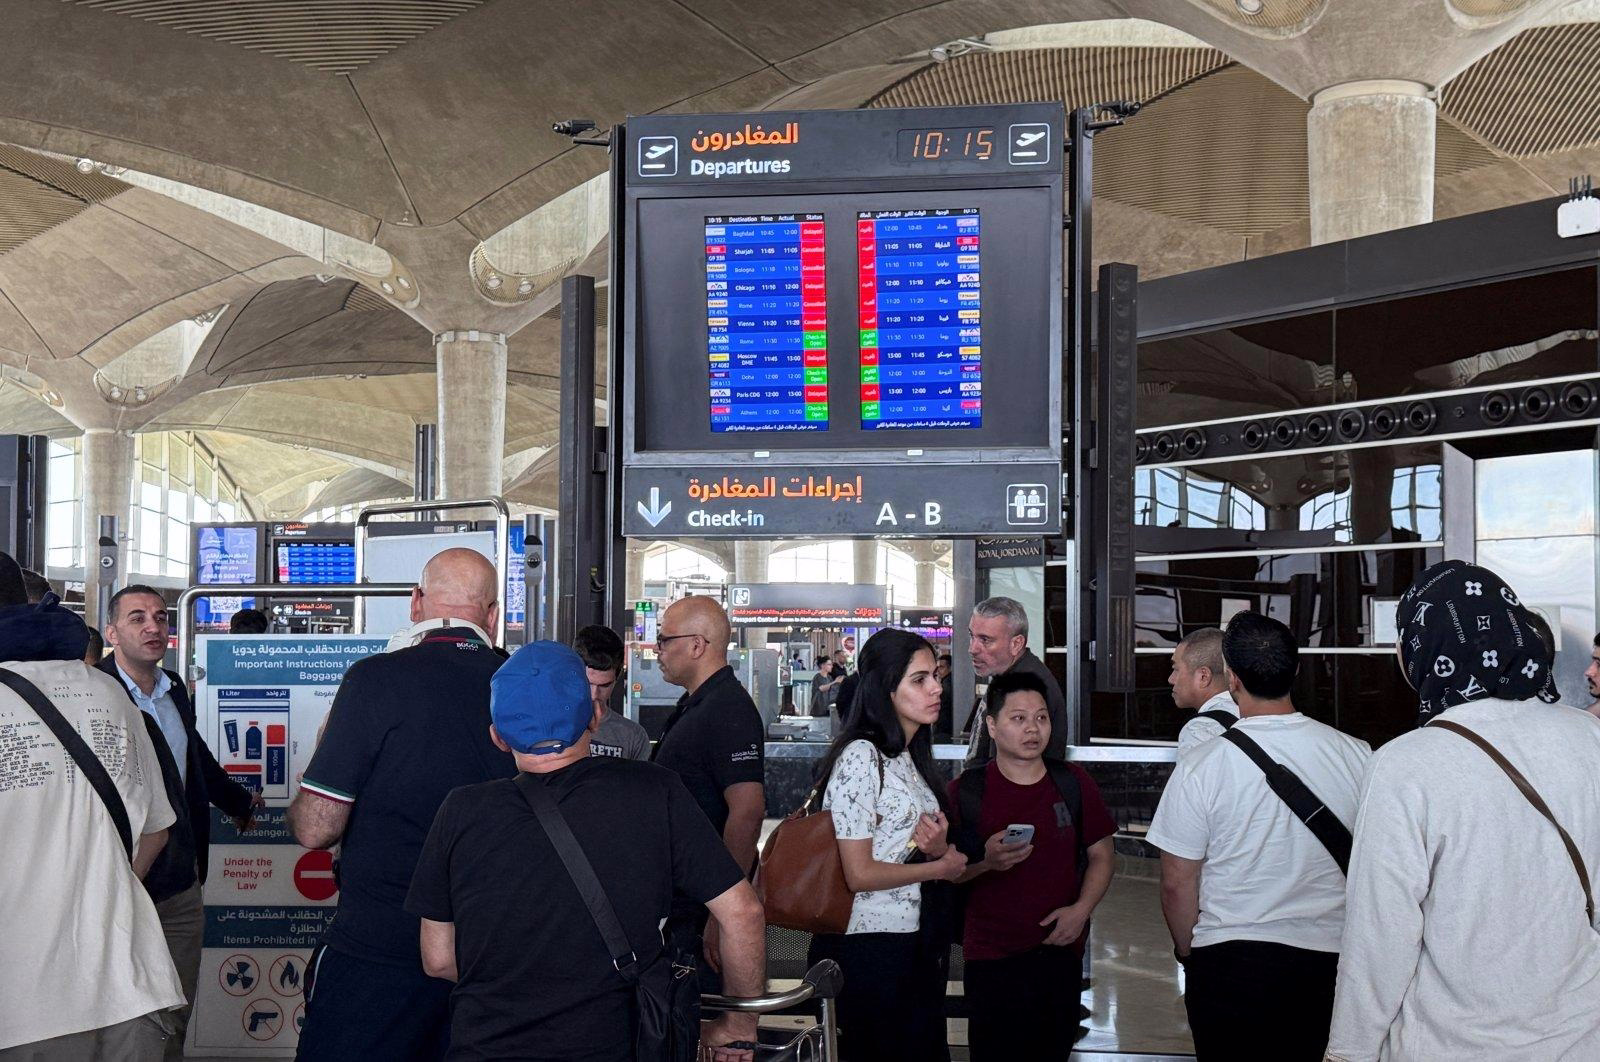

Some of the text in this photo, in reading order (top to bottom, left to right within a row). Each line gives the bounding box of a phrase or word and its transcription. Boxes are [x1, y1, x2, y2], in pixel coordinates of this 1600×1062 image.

[690, 122, 799, 153] المغادرون
[912, 130, 994, 161] 10:15
[690, 158, 790, 178] Departures
[688, 474, 864, 504] إجراءات المغادرة
[688, 510, 765, 528] Check-in
[875, 502, 898, 526] A
[924, 502, 942, 526] B
[1000, 546, 1040, 558] JORDANIAN
[232, 645, 257, 656] يدويا
[258, 645, 303, 656] المحمولة
[305, 645, 342, 656] للحقائب
[235, 660, 343, 670] Important Instructions
[299, 672, 342, 682] Baggage
[224, 858, 272, 867] Under the
[223, 869, 273, 880] Penalty of
[237, 882, 257, 890] Law
[217, 909, 323, 922] الحقائب المشحونة على
[290, 924, 322, 934] الطائرة
[224, 935, 316, 944] Items Prohibited in
